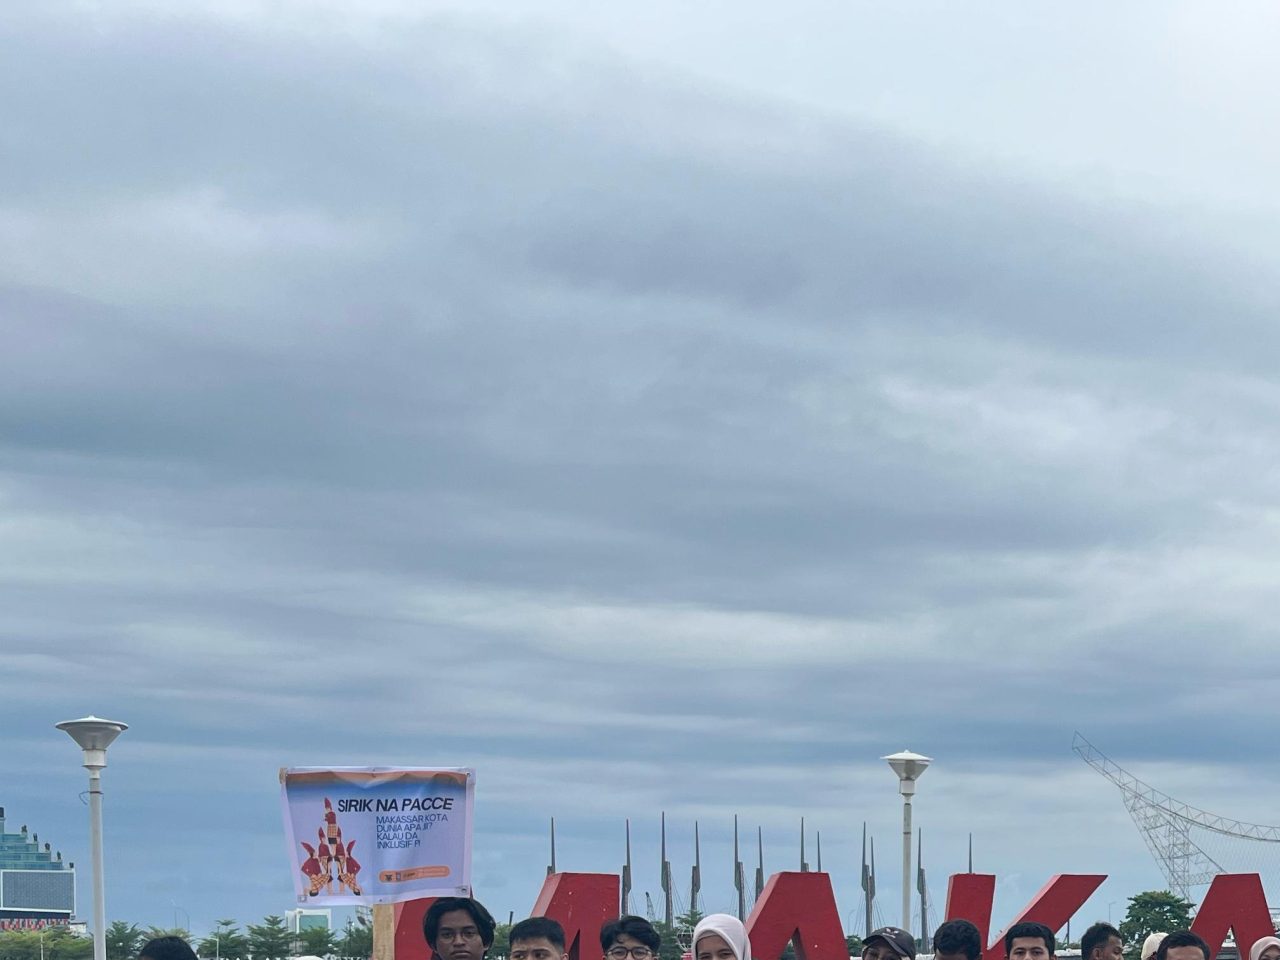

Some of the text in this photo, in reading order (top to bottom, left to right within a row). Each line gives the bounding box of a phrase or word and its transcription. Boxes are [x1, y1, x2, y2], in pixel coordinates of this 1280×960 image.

[338, 798, 454, 812] SIRIK NA PACCE
[376, 814, 448, 824] MAKASSAR KOTA
[376, 824, 402, 832] DUNIA
[404, 823, 421, 831] APA
[377, 832, 404, 840] KALAU
[377, 841, 412, 849] INKLUSIF
